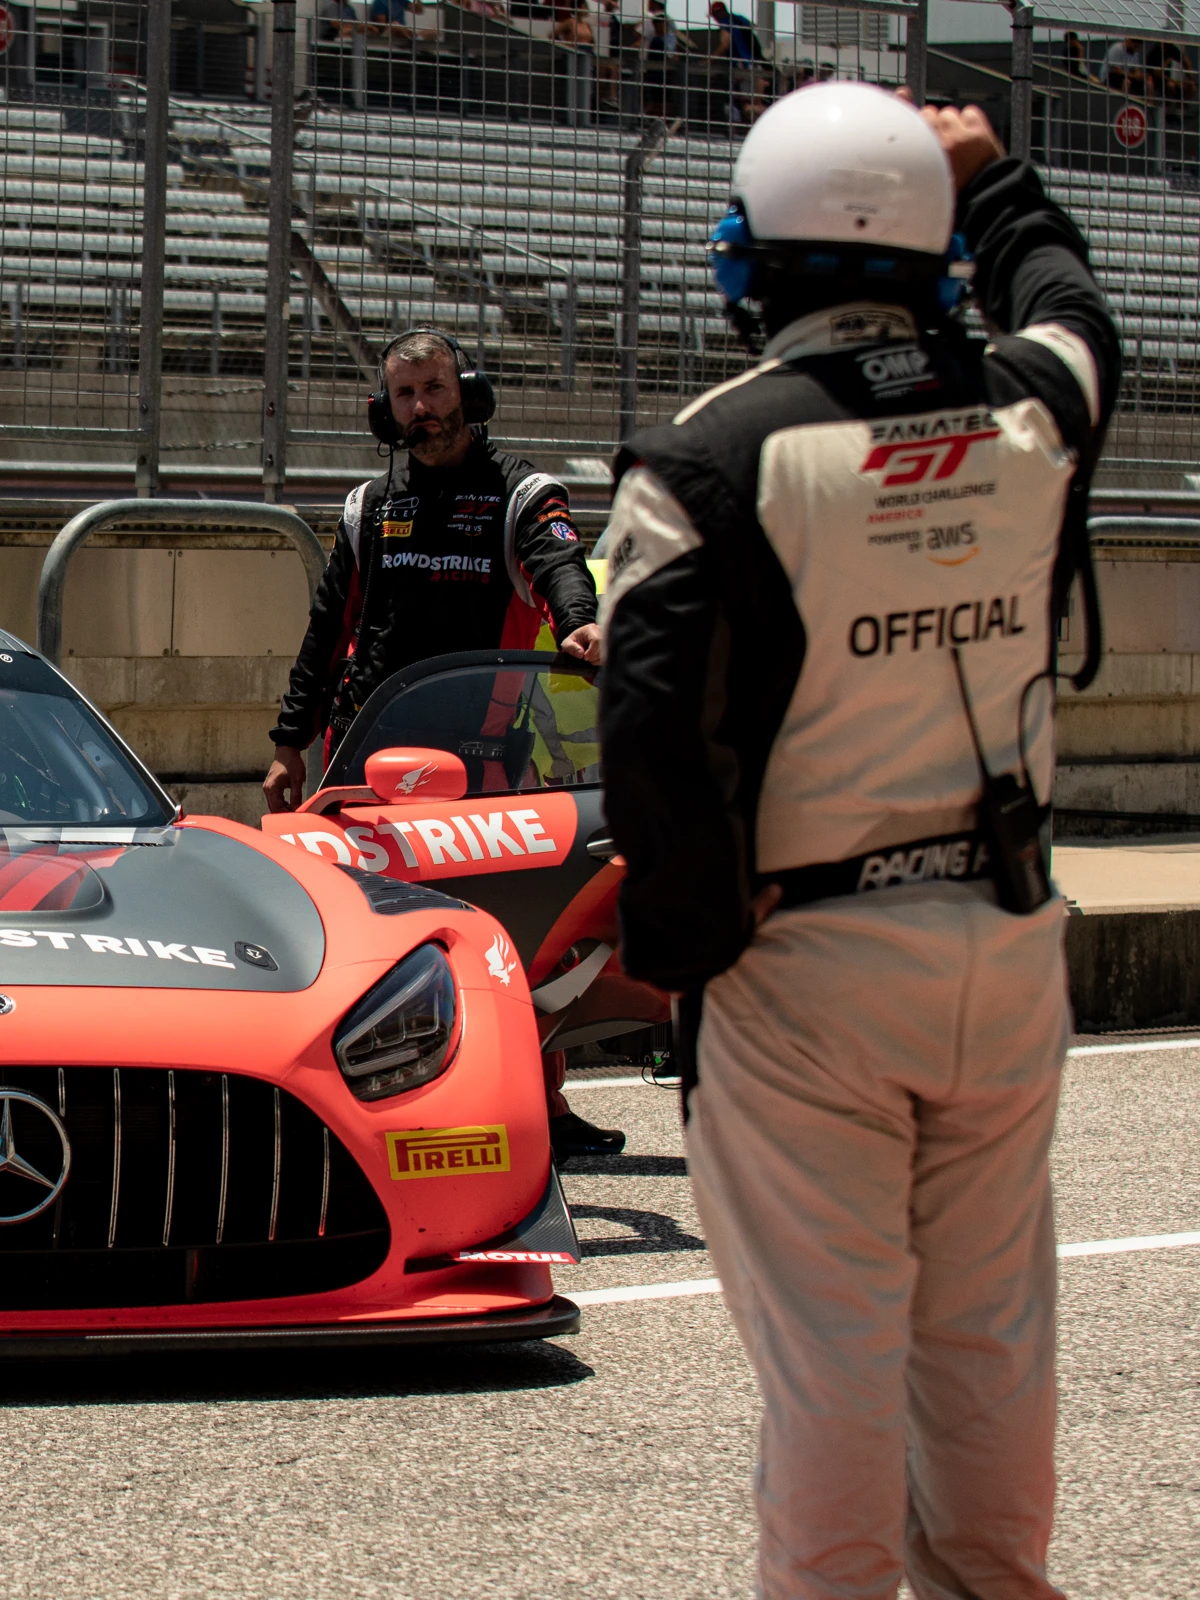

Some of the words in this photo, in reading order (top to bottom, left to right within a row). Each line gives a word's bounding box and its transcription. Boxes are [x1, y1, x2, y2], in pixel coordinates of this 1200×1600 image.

[862, 349, 929, 382] OMP
[871, 412, 998, 440] FANATEC
[860, 429, 1002, 487] GT
[874, 493, 920, 509] WORLD
[922, 483, 996, 505] CHALLENGE
[866, 508, 924, 524] AMERICA
[867, 530, 921, 546] POWERED
[926, 521, 978, 550] aws
[382, 552, 491, 573] ROWDSTRIKE
[848, 595, 1025, 658] OFFICIAL
[280, 808, 557, 872] DSTRIKE
[394, 1132, 501, 1173] PIRELLI
[459, 1252, 569, 1262] MOTUL
